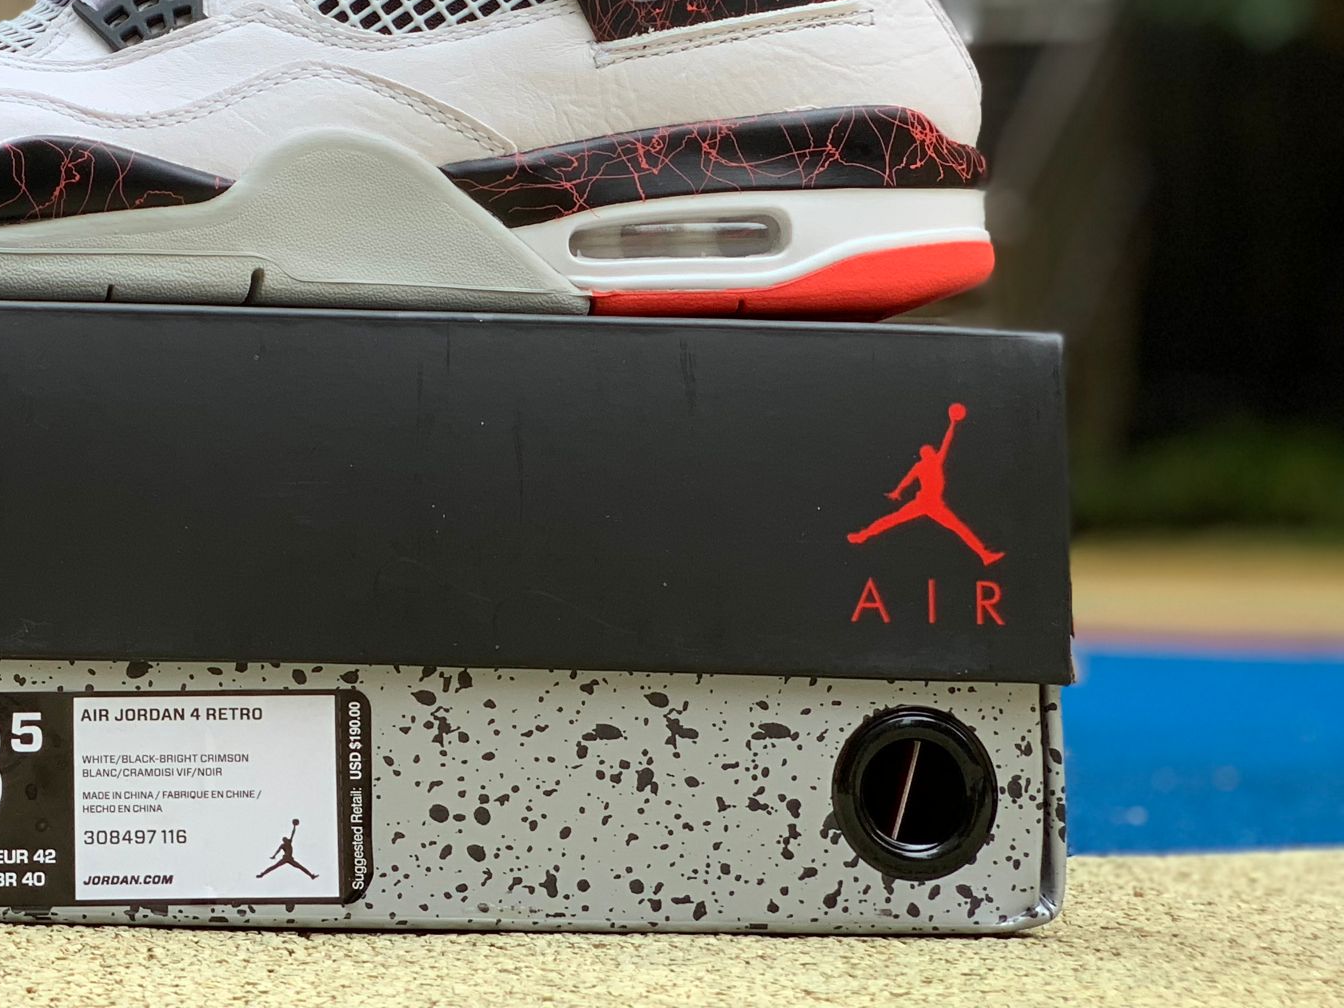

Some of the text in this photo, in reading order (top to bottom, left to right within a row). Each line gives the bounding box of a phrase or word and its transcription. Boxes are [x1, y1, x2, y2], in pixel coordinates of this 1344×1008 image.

[850, 576, 1006, 626] AIR
[81, 707, 263, 722] AIR JORDAN 4 RETRO
[11, 712, 43, 753] 5
[82, 753, 249, 765] WHITE/BLACK-BRIGHT CRIMSON
[82, 767, 222, 778] BLANC/CRAMOISI VIF/NOIR
[82, 791, 110, 800] MADE
[112, 791, 122, 800] IN
[123, 791, 153, 800] CHINA
[162, 790, 209, 800] FABRIQUE
[211, 790, 224, 799] EN
[225, 789, 255, 799] CHINE
[348, 701, 367, 890] Suggested Retail: USD $190.00
[82, 804, 163, 814] HECHO EN CHINA
[33, 849, 57, 863] 42
[22, 872, 46, 887] 40
[83, 875, 174, 886] JORDAN.COM
